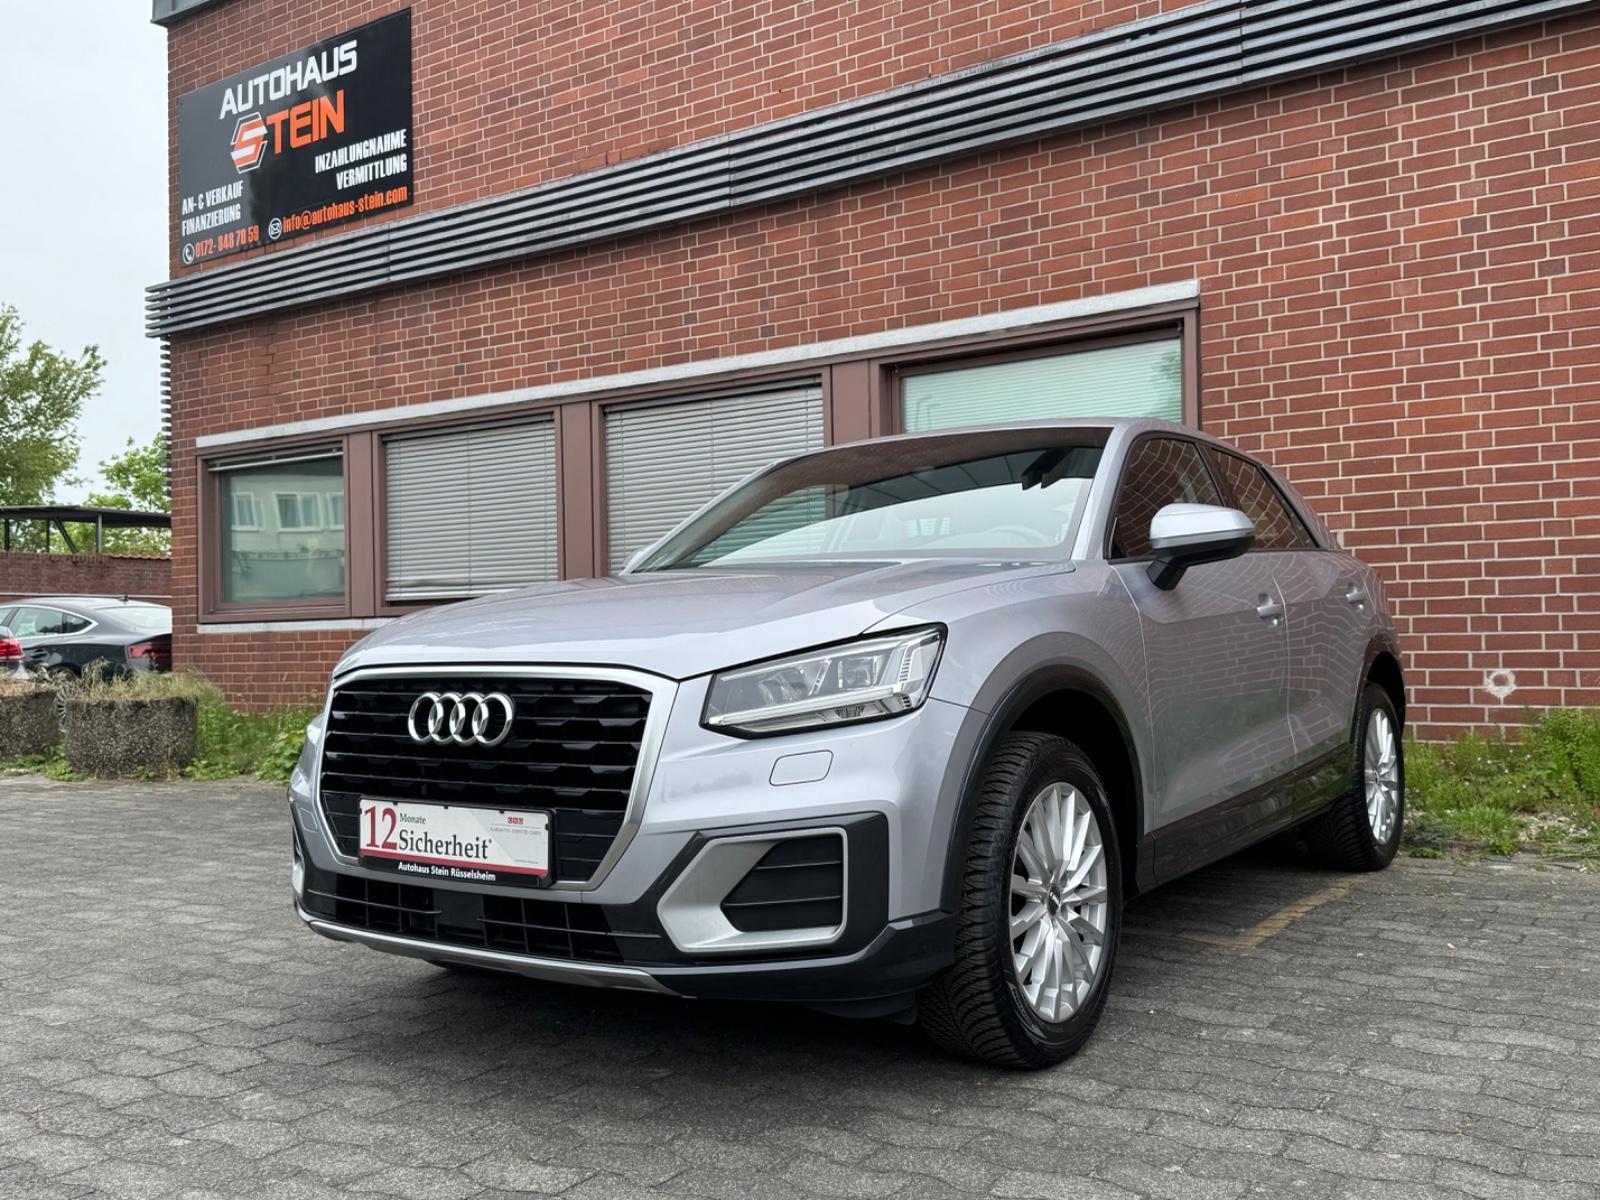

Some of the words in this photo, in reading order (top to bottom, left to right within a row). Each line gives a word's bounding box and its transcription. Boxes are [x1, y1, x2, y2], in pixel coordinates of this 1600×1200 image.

[219, 40, 358, 120] AUTOHAUS
[231, 89, 345, 174] STEIN
[315, 128, 407, 174] INZAHLUNGNAHME
[336, 153, 408, 190] VERMITTLUNG
[182, 196, 197, 215] AN-
[206, 180, 244, 208] VERKAUF
[283, 186, 408, 234] info@autohaus-stein.com
[182, 203, 241, 237] FINANZIERUNG
[364, 806, 398, 851] 12
[400, 812, 427, 825] Monate
[398, 861, 430, 875] Autohaus
[431, 865, 449, 877] Stein
[450, 866, 496, 882] Rüsselsheim
